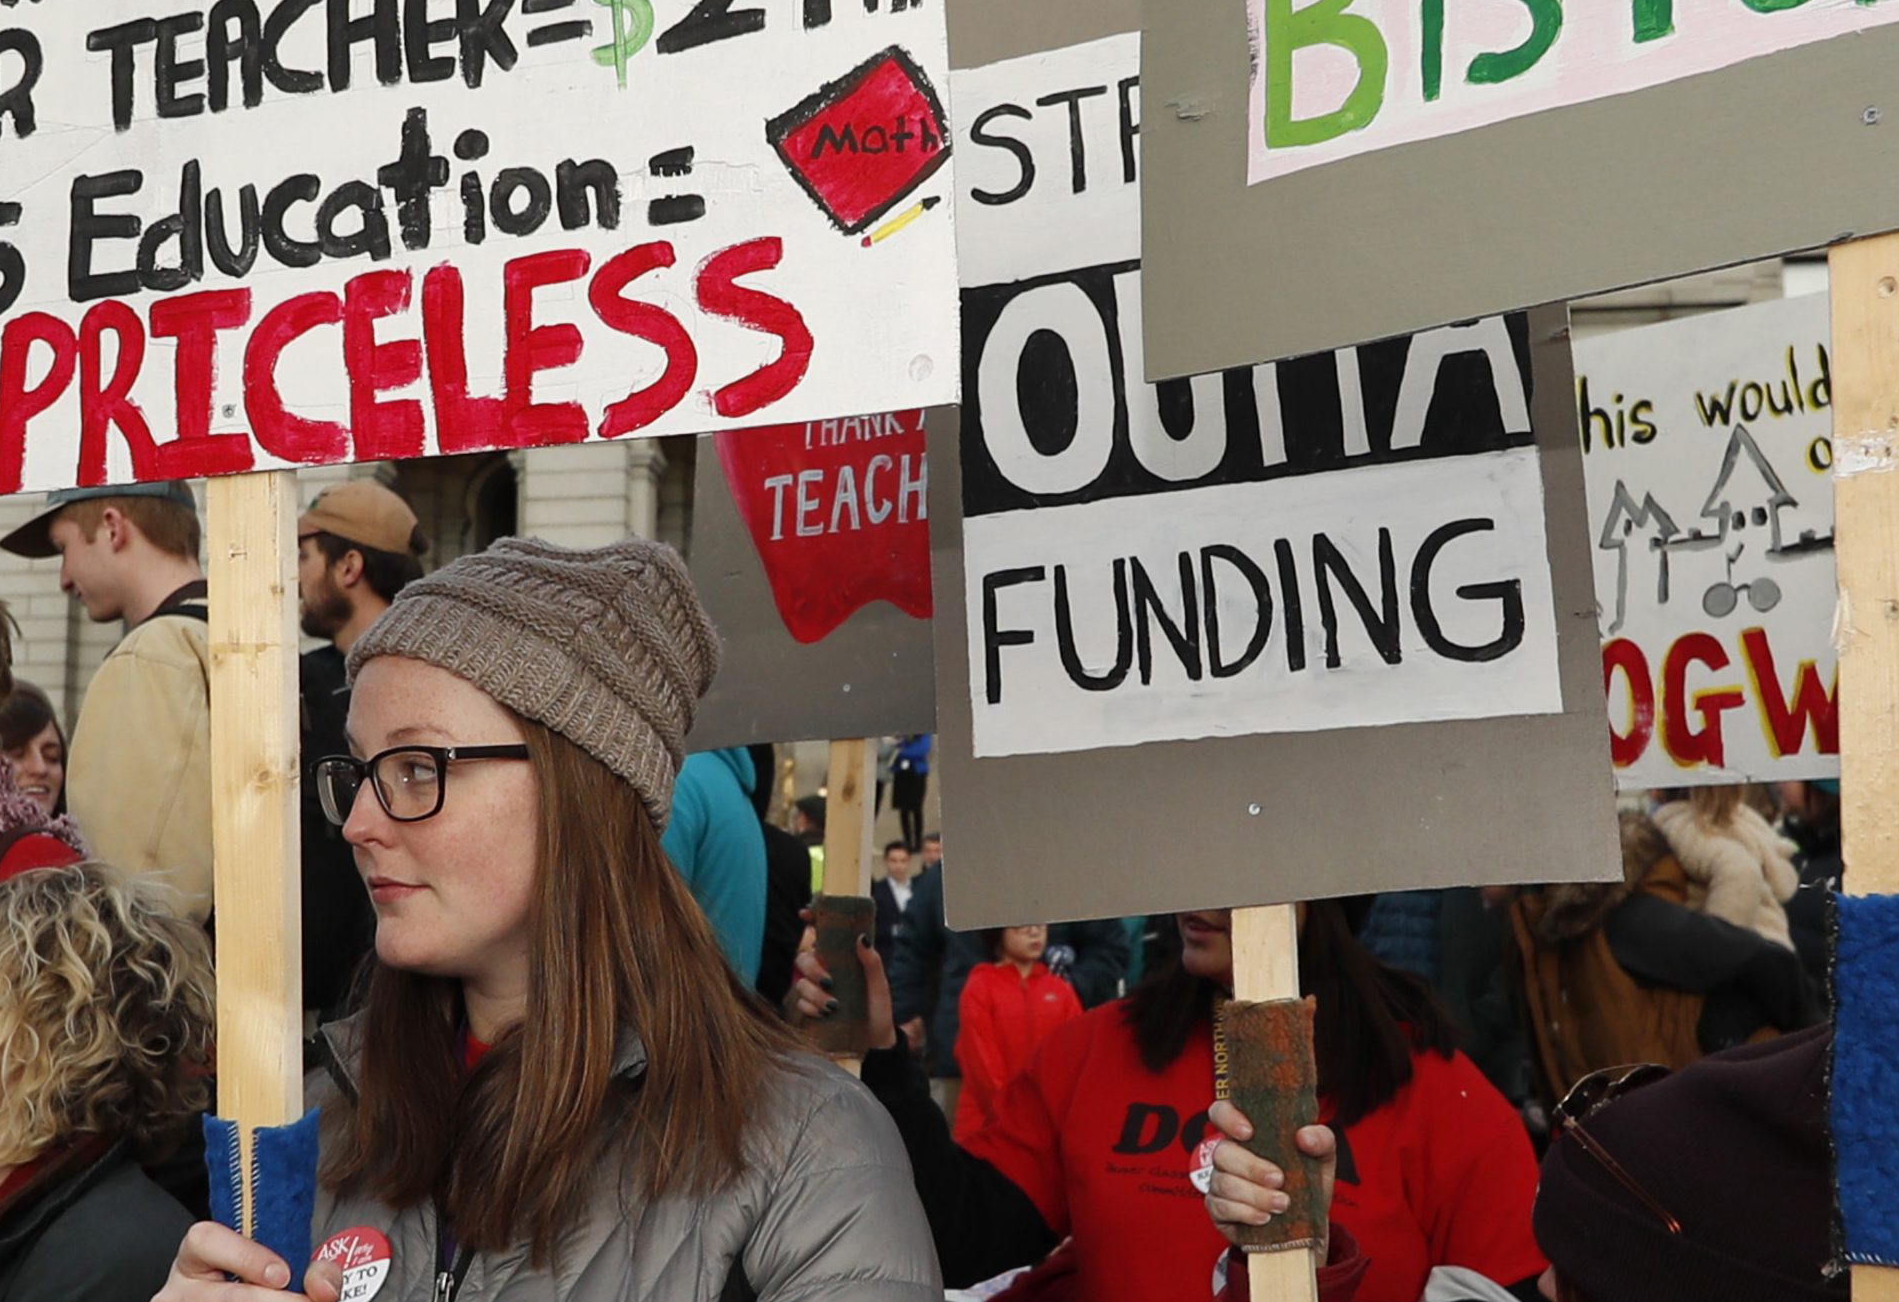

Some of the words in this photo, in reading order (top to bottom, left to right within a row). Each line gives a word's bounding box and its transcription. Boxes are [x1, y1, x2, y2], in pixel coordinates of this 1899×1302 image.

[811, 115, 939, 158] Math
[68, 108, 619, 300] Education
[982, 517, 1526, 704] FUNDING
[356, 1265, 379, 1281] TO
